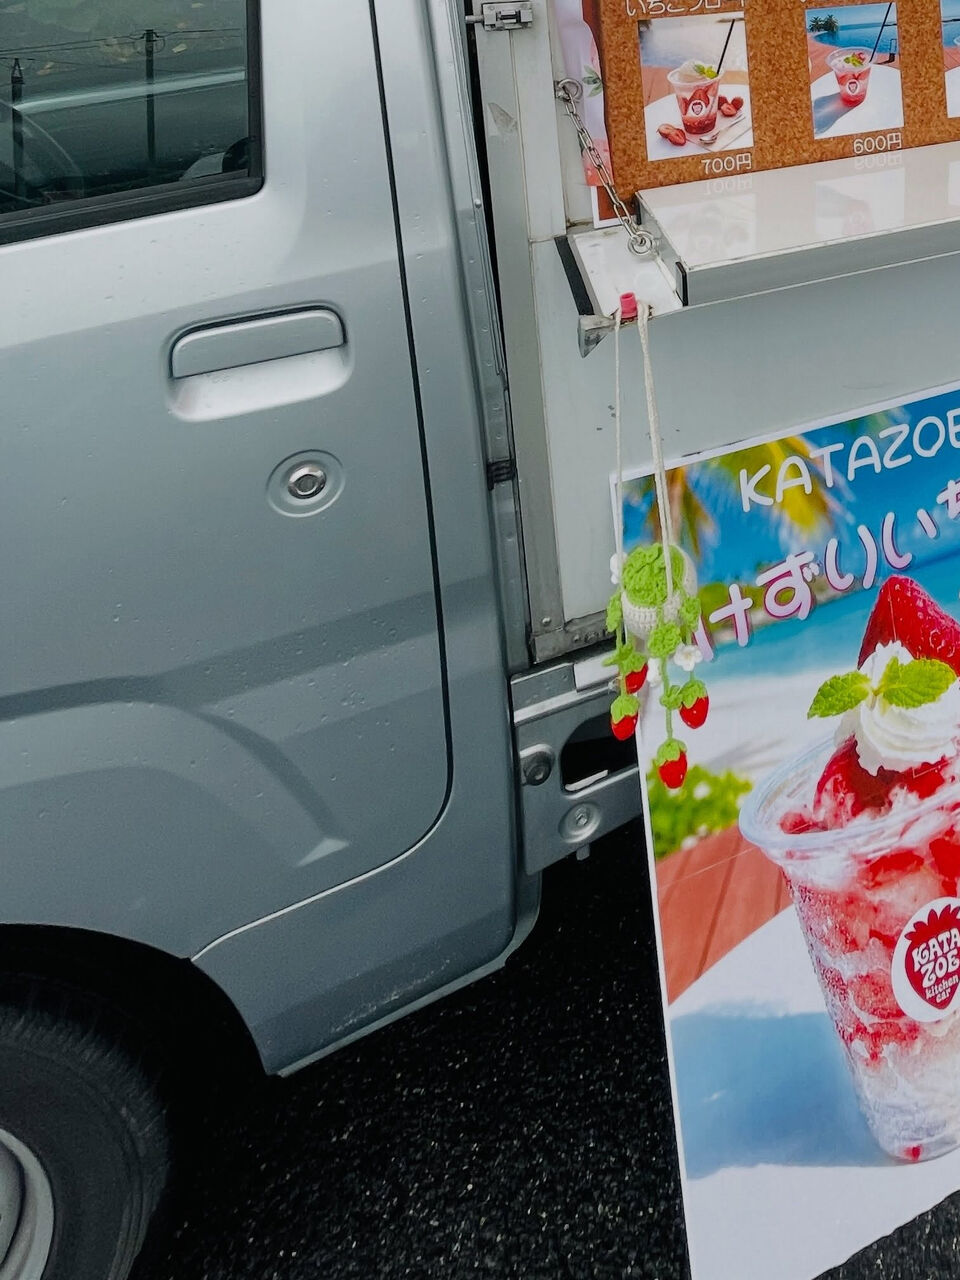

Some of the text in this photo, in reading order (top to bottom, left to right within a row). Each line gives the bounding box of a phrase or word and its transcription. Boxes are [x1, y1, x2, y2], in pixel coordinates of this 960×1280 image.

[853, 132, 903, 155] 600円
[701, 152, 752, 175] 700円
[920, 949, 960, 988] ZOE
[925, 974, 959, 1000] kitchen
[935, 988, 951, 1003] car
